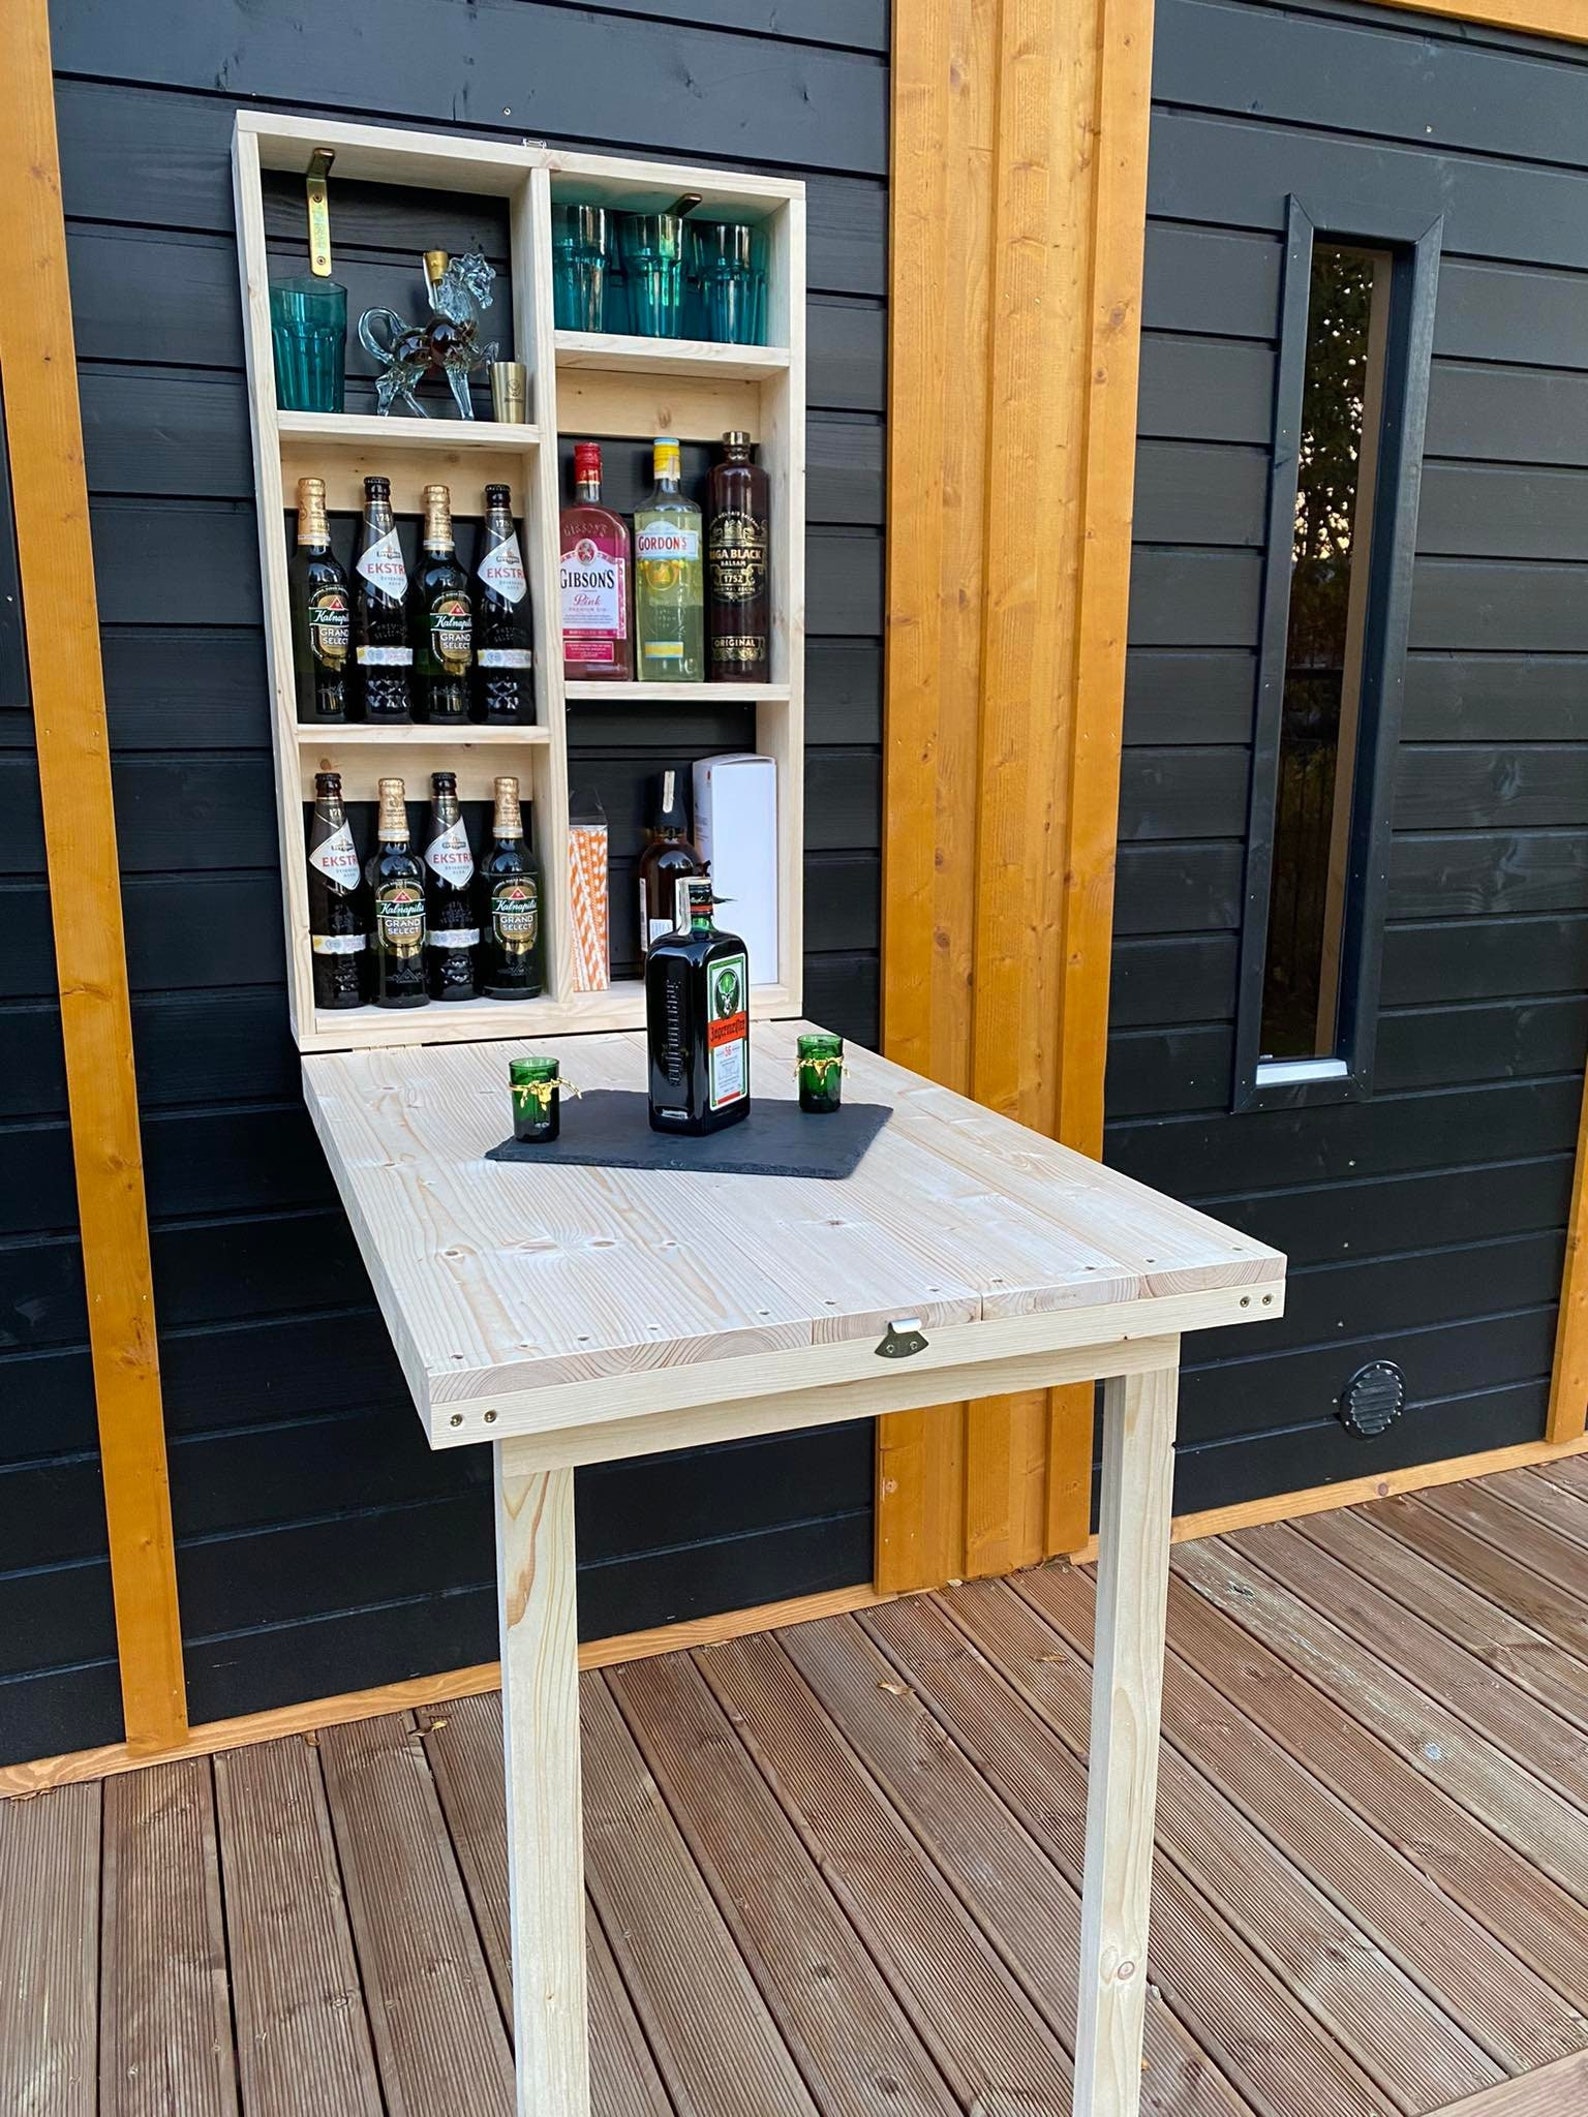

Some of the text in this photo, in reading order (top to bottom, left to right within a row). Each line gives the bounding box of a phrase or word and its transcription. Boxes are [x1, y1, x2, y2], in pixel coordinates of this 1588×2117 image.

[638, 536, 687, 551] GORDON'S
[730, 548, 761, 560] BLACK
[560, 568, 615, 590] GIBSON'S
[724, 574, 743, 583] 1752
[573, 592, 602, 607] Pink
[320, 627, 349, 637] GRAND
[440, 633, 471, 642] GRAND
[443, 642, 470, 650] SELECT
[713, 638, 756, 648] ORIGINAL
[384, 918, 421, 928] GRAND
[500, 915, 534, 924] GRAND
[387, 927, 419, 935] SELECT
[502, 923, 532, 931] SELECT
